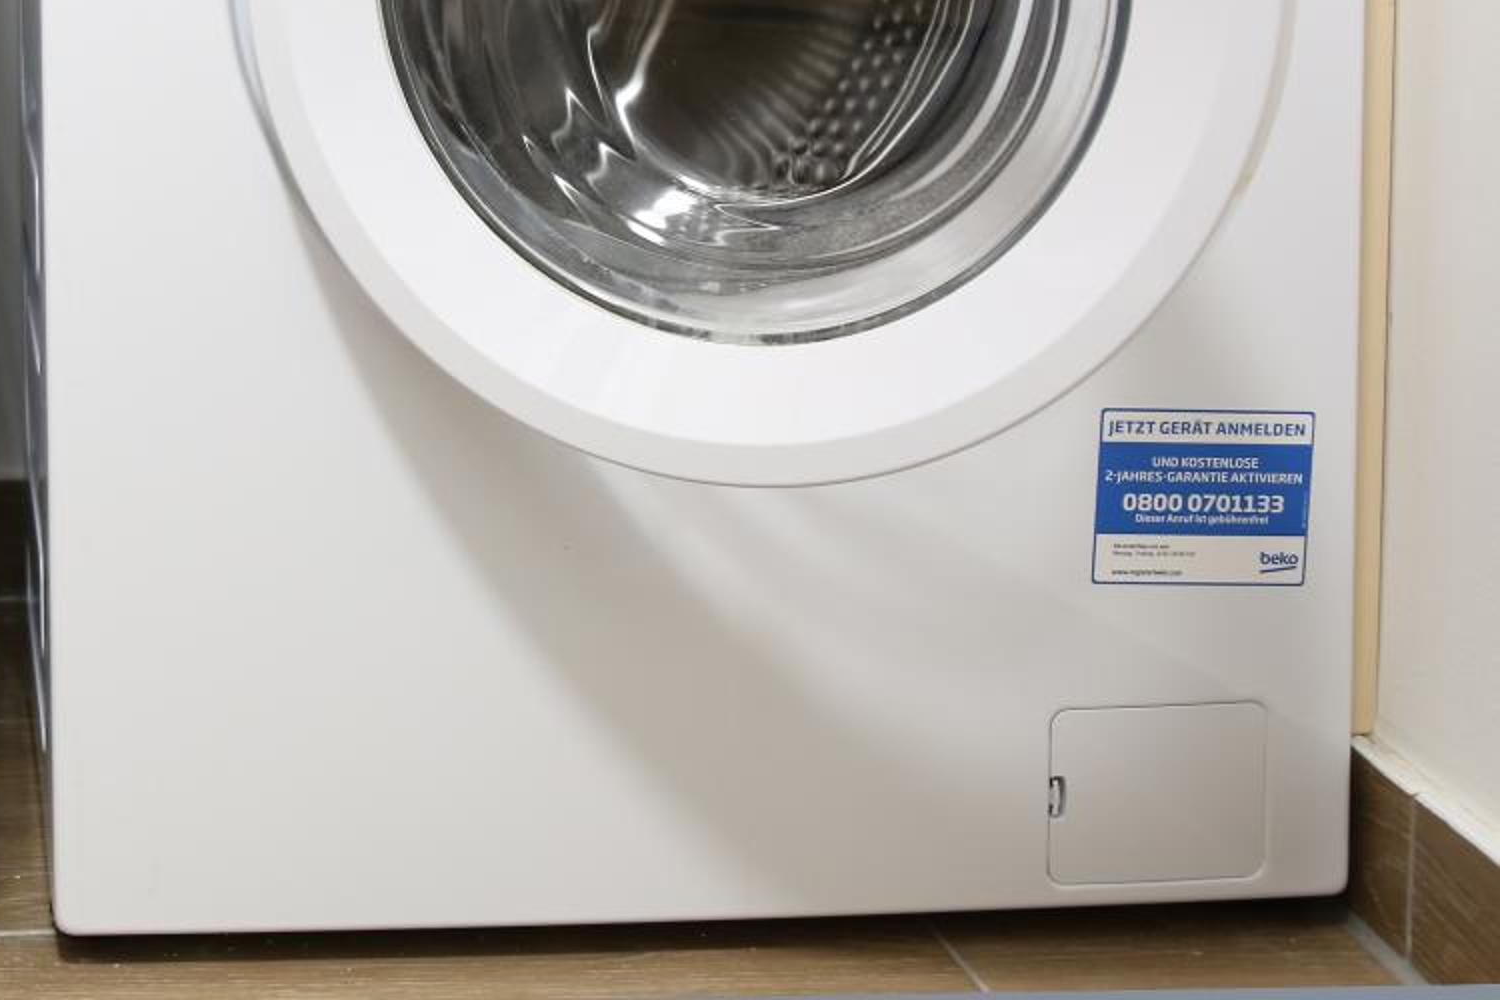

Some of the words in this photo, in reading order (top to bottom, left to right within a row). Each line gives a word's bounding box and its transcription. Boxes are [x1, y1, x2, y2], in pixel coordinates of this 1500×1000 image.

[1107, 420, 1156, 437] JETZT
[1160, 418, 1211, 436] GERÄT
[1216, 422, 1307, 437] ANMELDEN
[1152, 456, 1179, 468] UND
[1181, 456, 1260, 469] KOSTENLOSE
[1104, 469, 1229, 485] 2-JAHRES-GARANTIE
[1231, 471, 1303, 485] AKTIVIEREN
[1123, 493, 1182, 512] 0800
[1188, 494, 1285, 514] 0701133
[1259, 551, 1299, 566] beko
